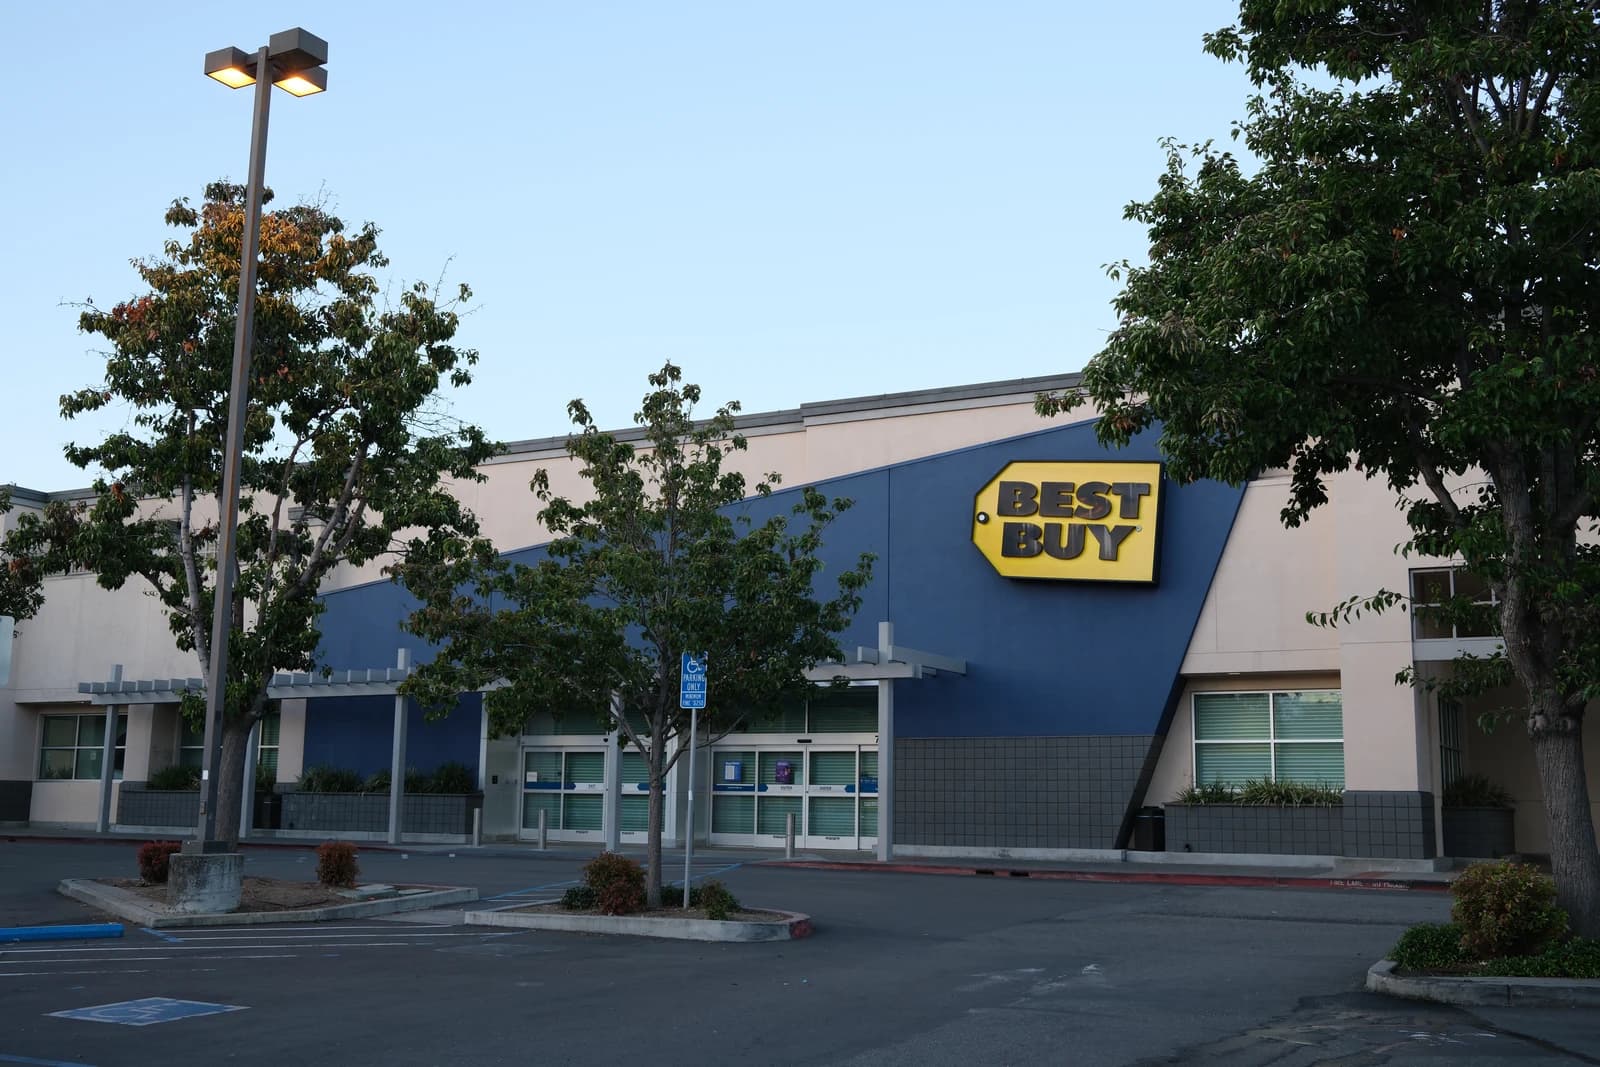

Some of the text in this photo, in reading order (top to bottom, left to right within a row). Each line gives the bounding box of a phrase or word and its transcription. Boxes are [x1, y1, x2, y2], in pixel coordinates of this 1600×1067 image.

[997, 480, 1151, 520] BEST
[1001, 522, 1137, 561] BUY
[683, 673, 705, 682] PARKING
[687, 682, 701, 691] ONLY
